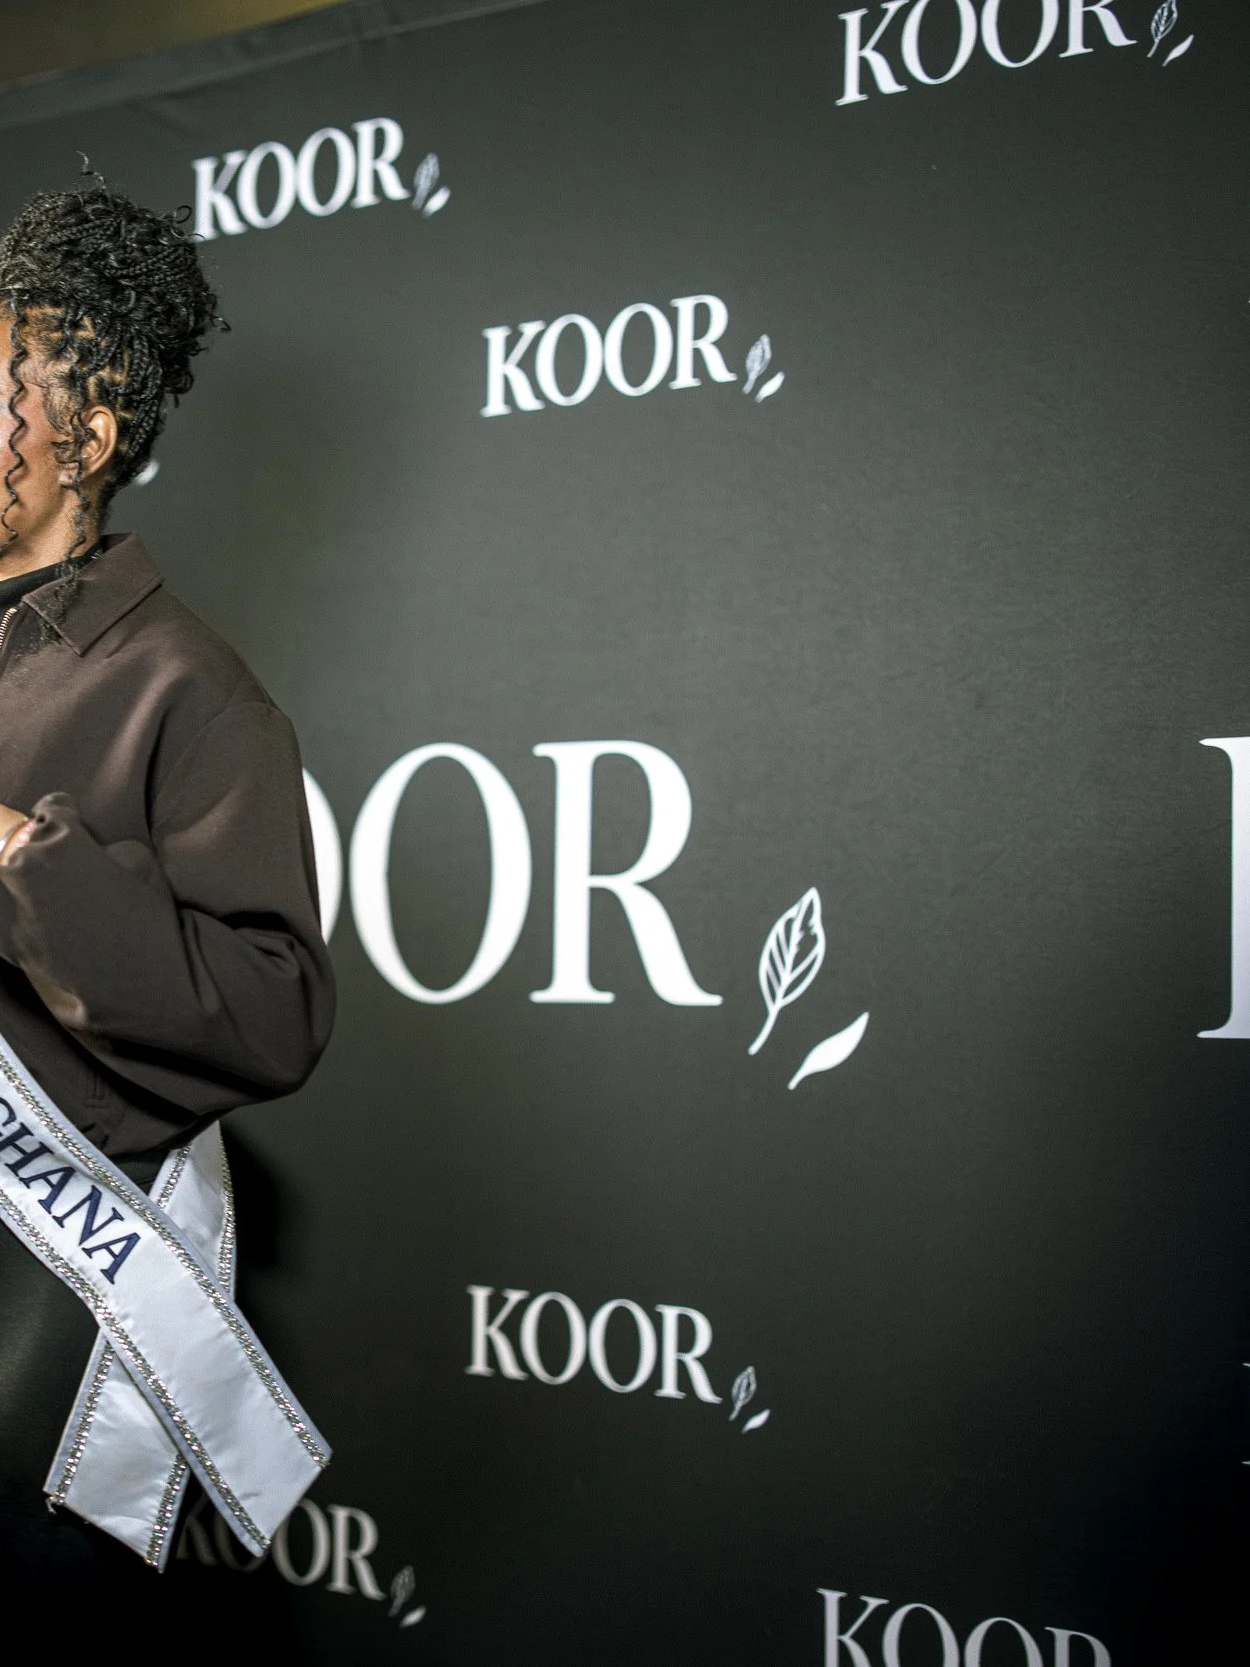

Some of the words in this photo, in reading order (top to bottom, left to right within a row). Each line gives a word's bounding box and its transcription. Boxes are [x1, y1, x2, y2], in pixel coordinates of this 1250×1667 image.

[191, 117, 411, 243] KOOR
[480, 294, 739, 418] KOOR
[464, 1284, 724, 1405] KOOR
